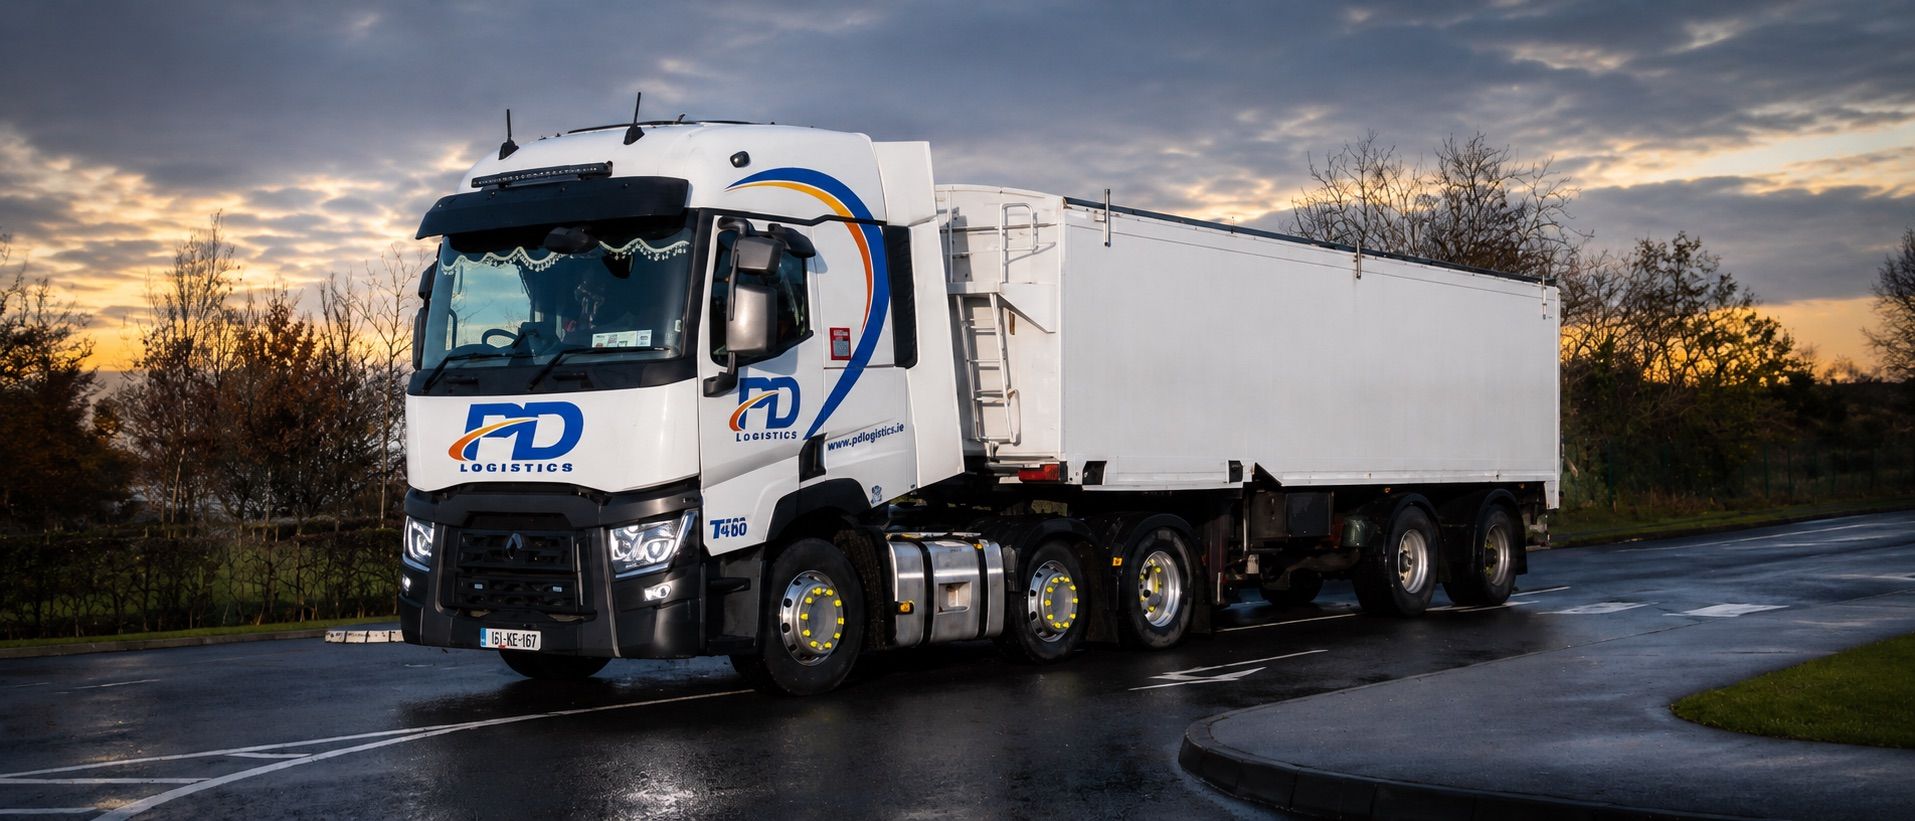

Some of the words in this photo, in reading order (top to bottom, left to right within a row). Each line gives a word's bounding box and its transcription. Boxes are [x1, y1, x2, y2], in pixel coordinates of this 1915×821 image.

[736, 376, 800, 430] PD
[462, 401, 584, 461] PD
[736, 431, 797, 442] LOGISTICS
[828, 423, 904, 451] www.pdlogistics.ie
[460, 463, 573, 473] LOGISTICS
[491, 631, 537, 648] 161-KE-167
